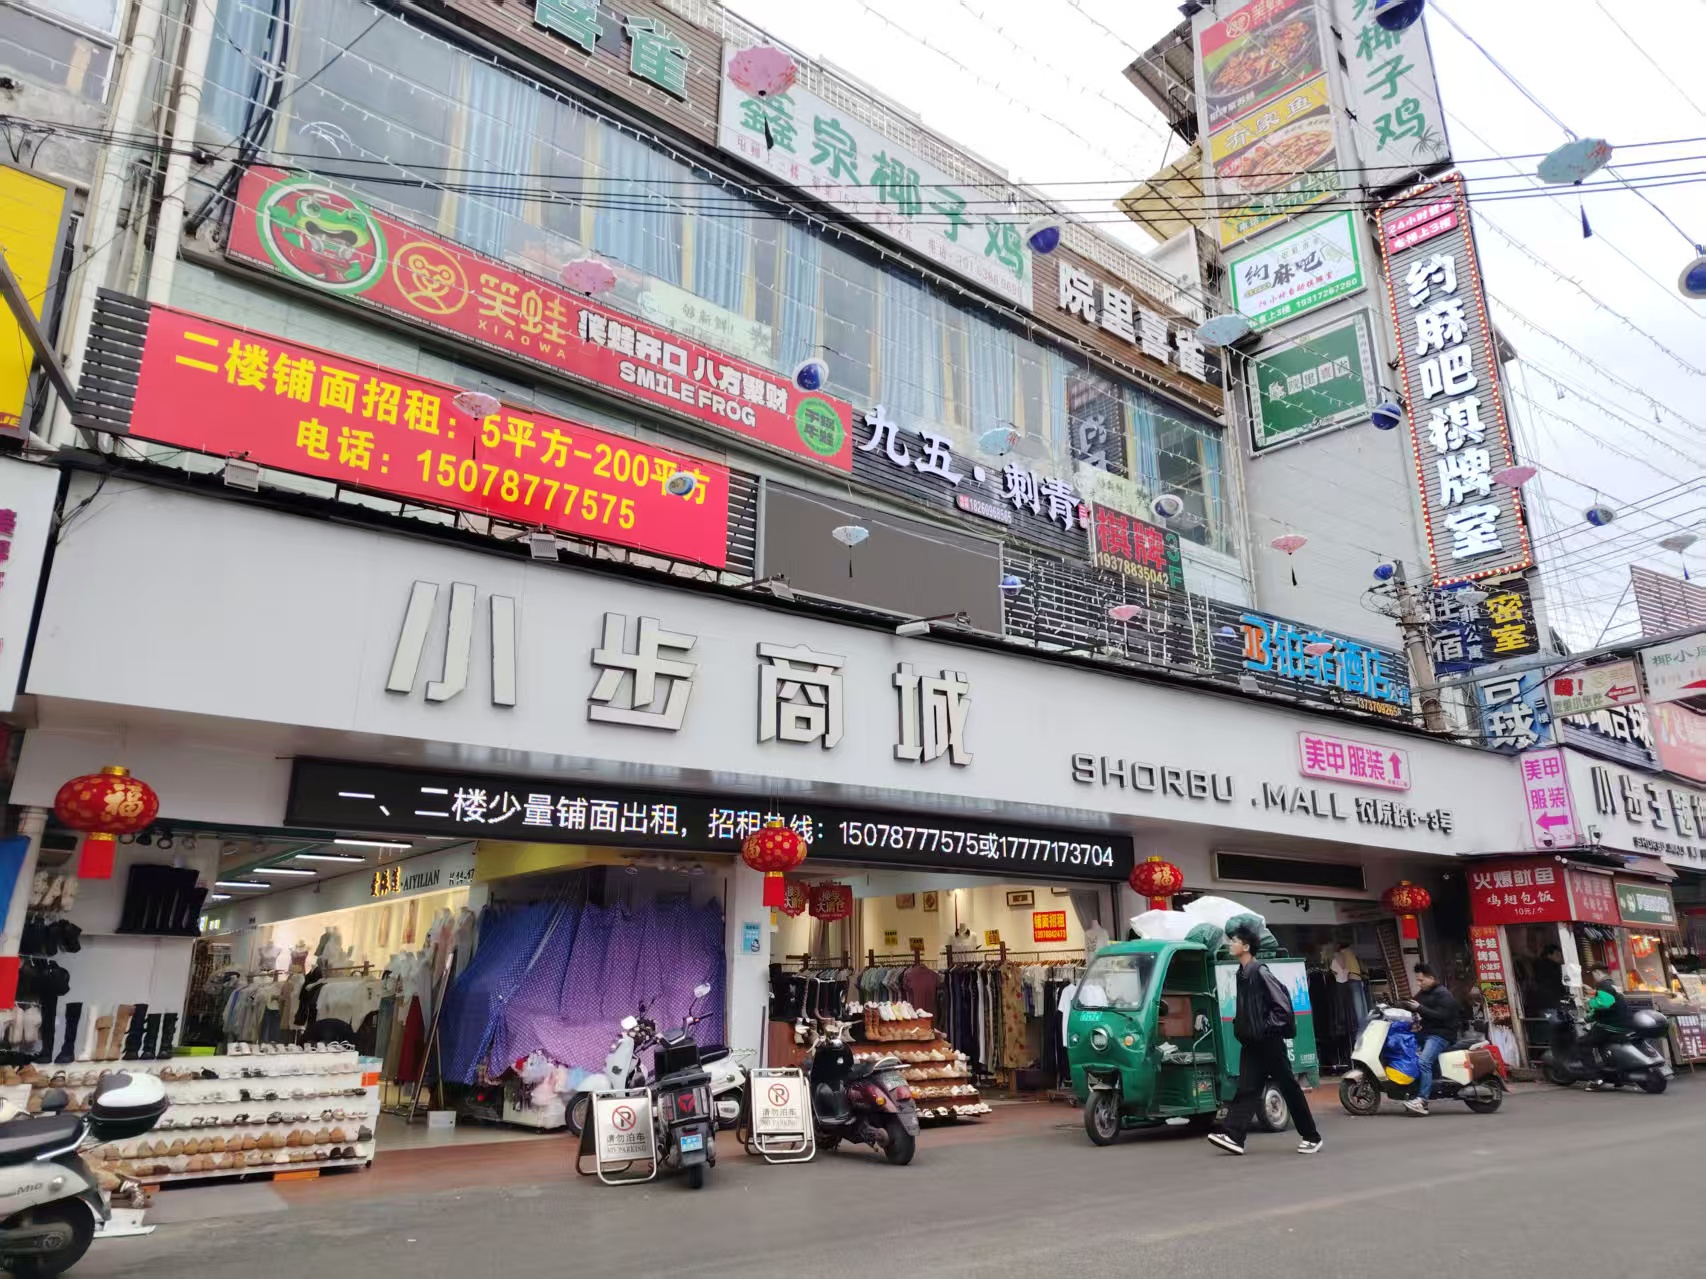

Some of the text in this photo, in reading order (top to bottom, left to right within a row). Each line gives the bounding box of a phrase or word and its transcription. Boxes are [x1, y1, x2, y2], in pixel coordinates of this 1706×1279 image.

[1351, 0, 1427, 151] 椰子鸡
[1245, 251, 1323, 288] 约麻吧
[478, 273, 567, 345] 笑蛙
[477, 319, 566, 360] XIAOWA
[619, 360, 756, 428] SMILE FROG
[1405, 253, 1504, 559] 约麻吧棋牌室
[296, 417, 636, 530] 电话：15078777575
[858, 404, 1081, 531] 九五·刺青
[1097, 507, 1166, 570] 棋牌
[1097, 551, 1169, 585] 19378835042
[1486, 594, 1530, 653] 密室
[384, 580, 975, 767] 小步商城
[1071, 753, 1235, 802] SHORBU
[1304, 737, 1386, 780] 美甲服装
[1524, 757, 1560, 781] 美甲
[103, 781, 145, 819] 福
[1530, 787, 1566, 810] 服装
[1473, 867, 1556, 890] 火爆鱿鱼
[1487, 890, 1555, 907] 鸡翅包饭
[607, 1132, 646, 1143] 请勿泊车
